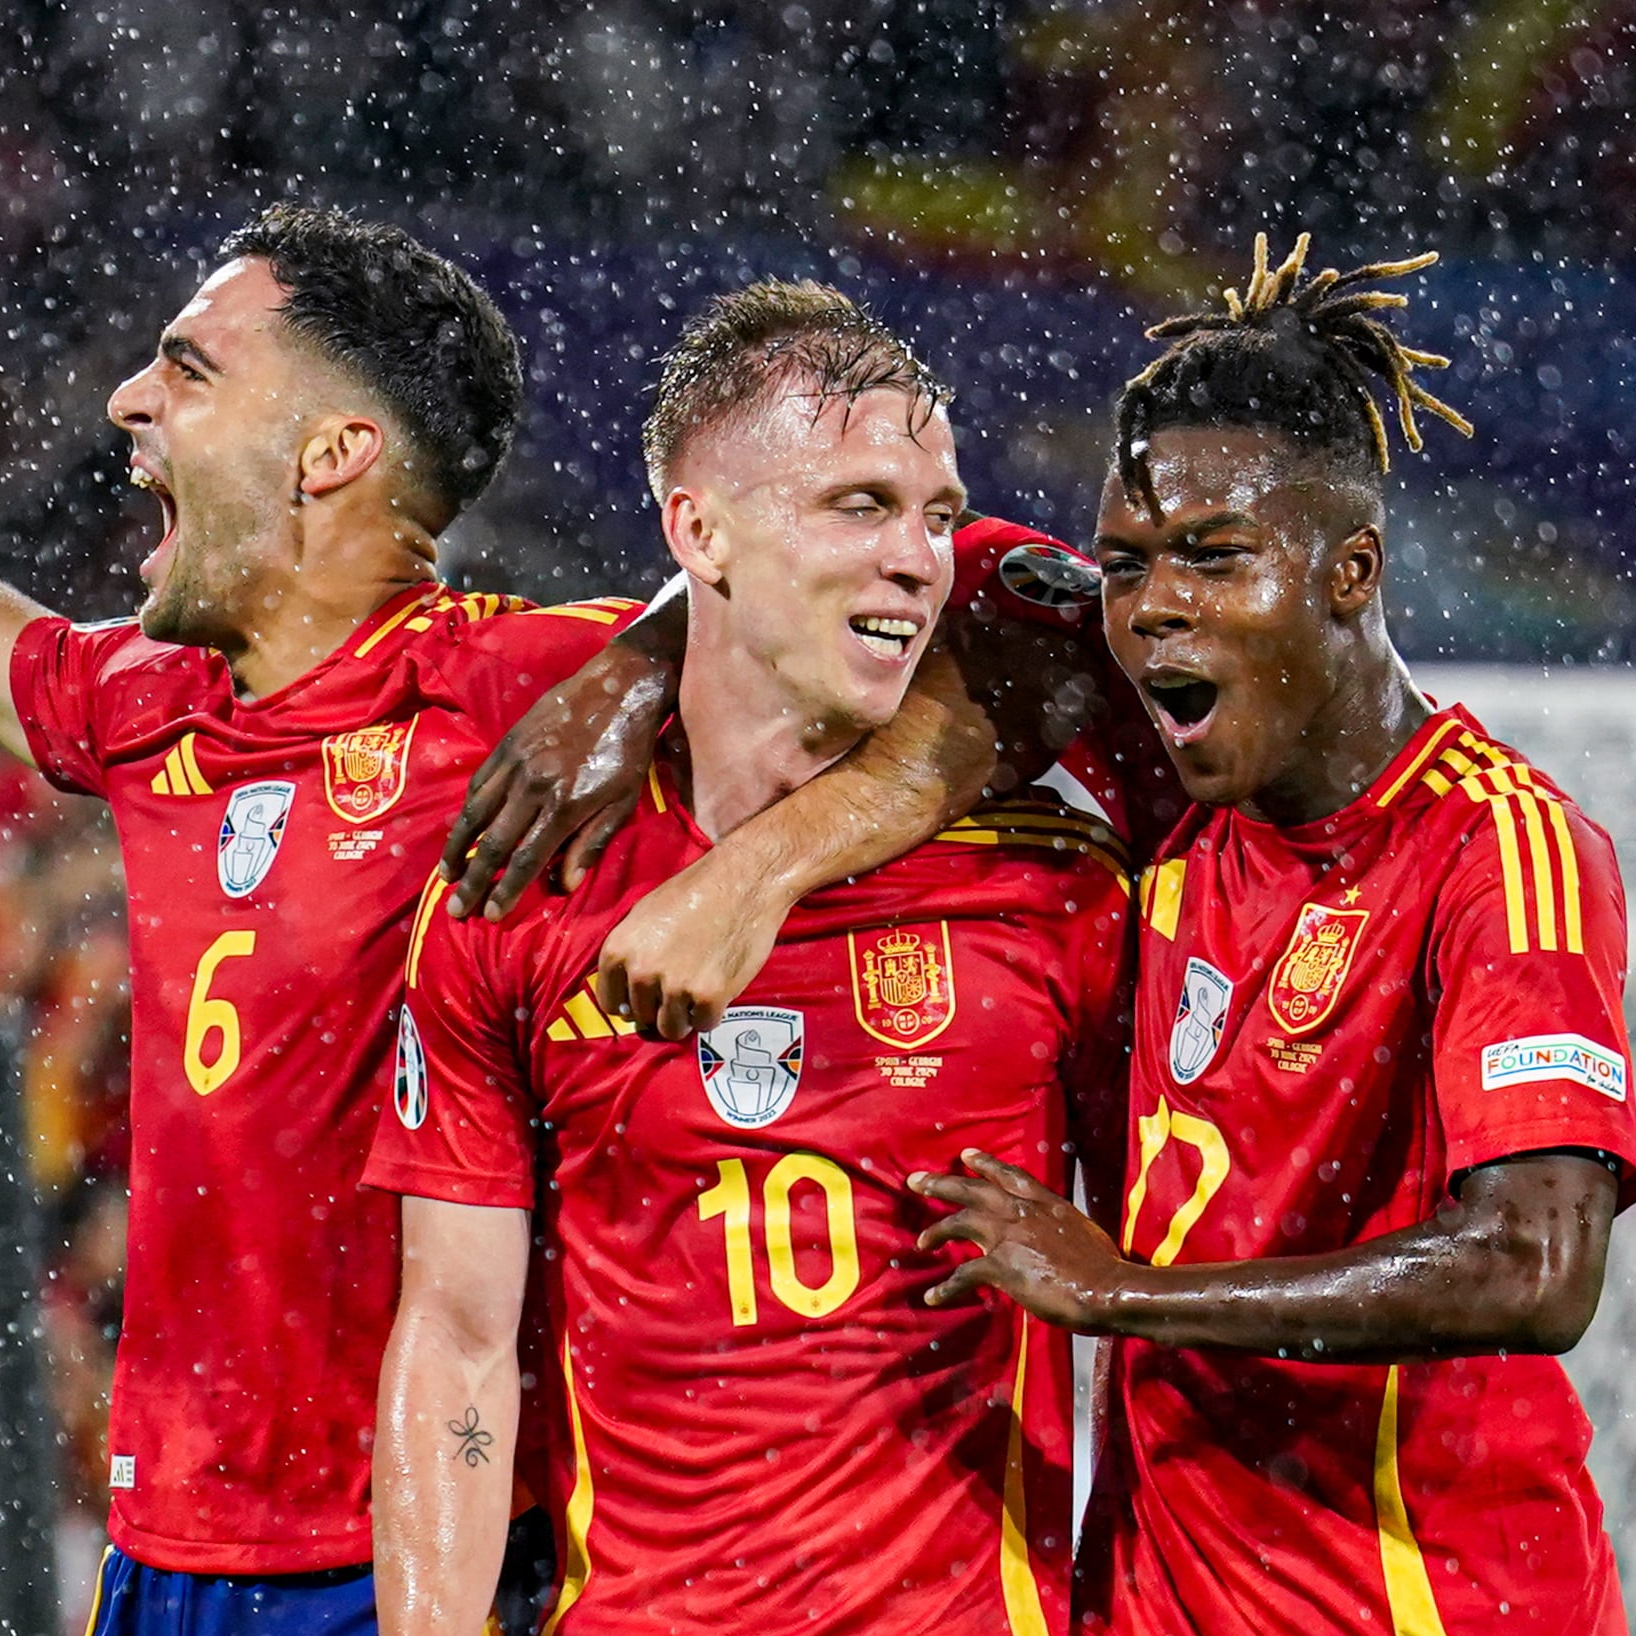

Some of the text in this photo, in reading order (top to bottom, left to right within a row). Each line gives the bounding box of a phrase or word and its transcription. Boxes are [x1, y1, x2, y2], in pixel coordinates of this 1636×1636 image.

[184, 931, 256, 1097] 6
[728, 1010, 764, 1019] NATIONS
[766, 1011, 798, 1021] LEAGUE
[1487, 1044, 1519, 1058] UEFA
[915, 1067, 938, 1077] 2024
[1487, 1049, 1622, 1085] FOUNDATION
[698, 1150, 861, 1327] 10
